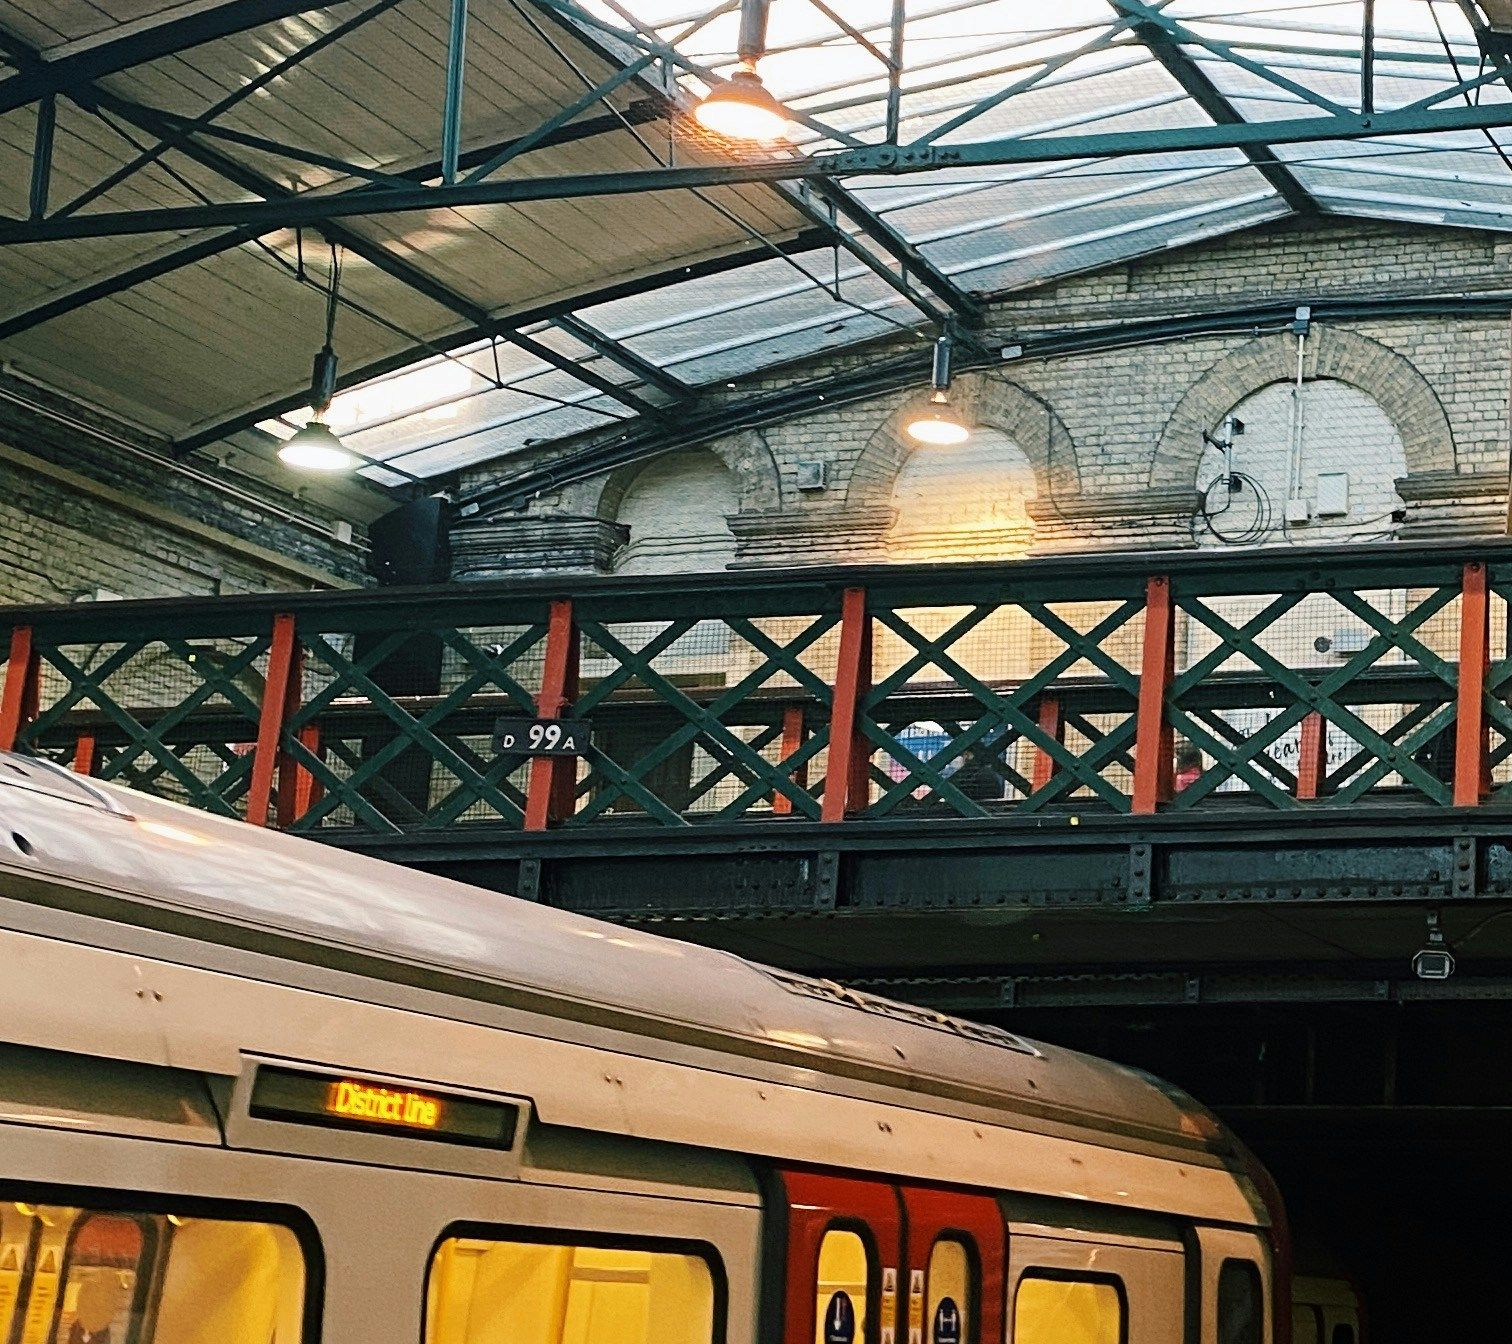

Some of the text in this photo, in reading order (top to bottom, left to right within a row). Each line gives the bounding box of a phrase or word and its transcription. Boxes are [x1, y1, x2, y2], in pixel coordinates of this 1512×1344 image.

[503, 734, 516, 749] D
[335, 1081, 437, 1127] District line
